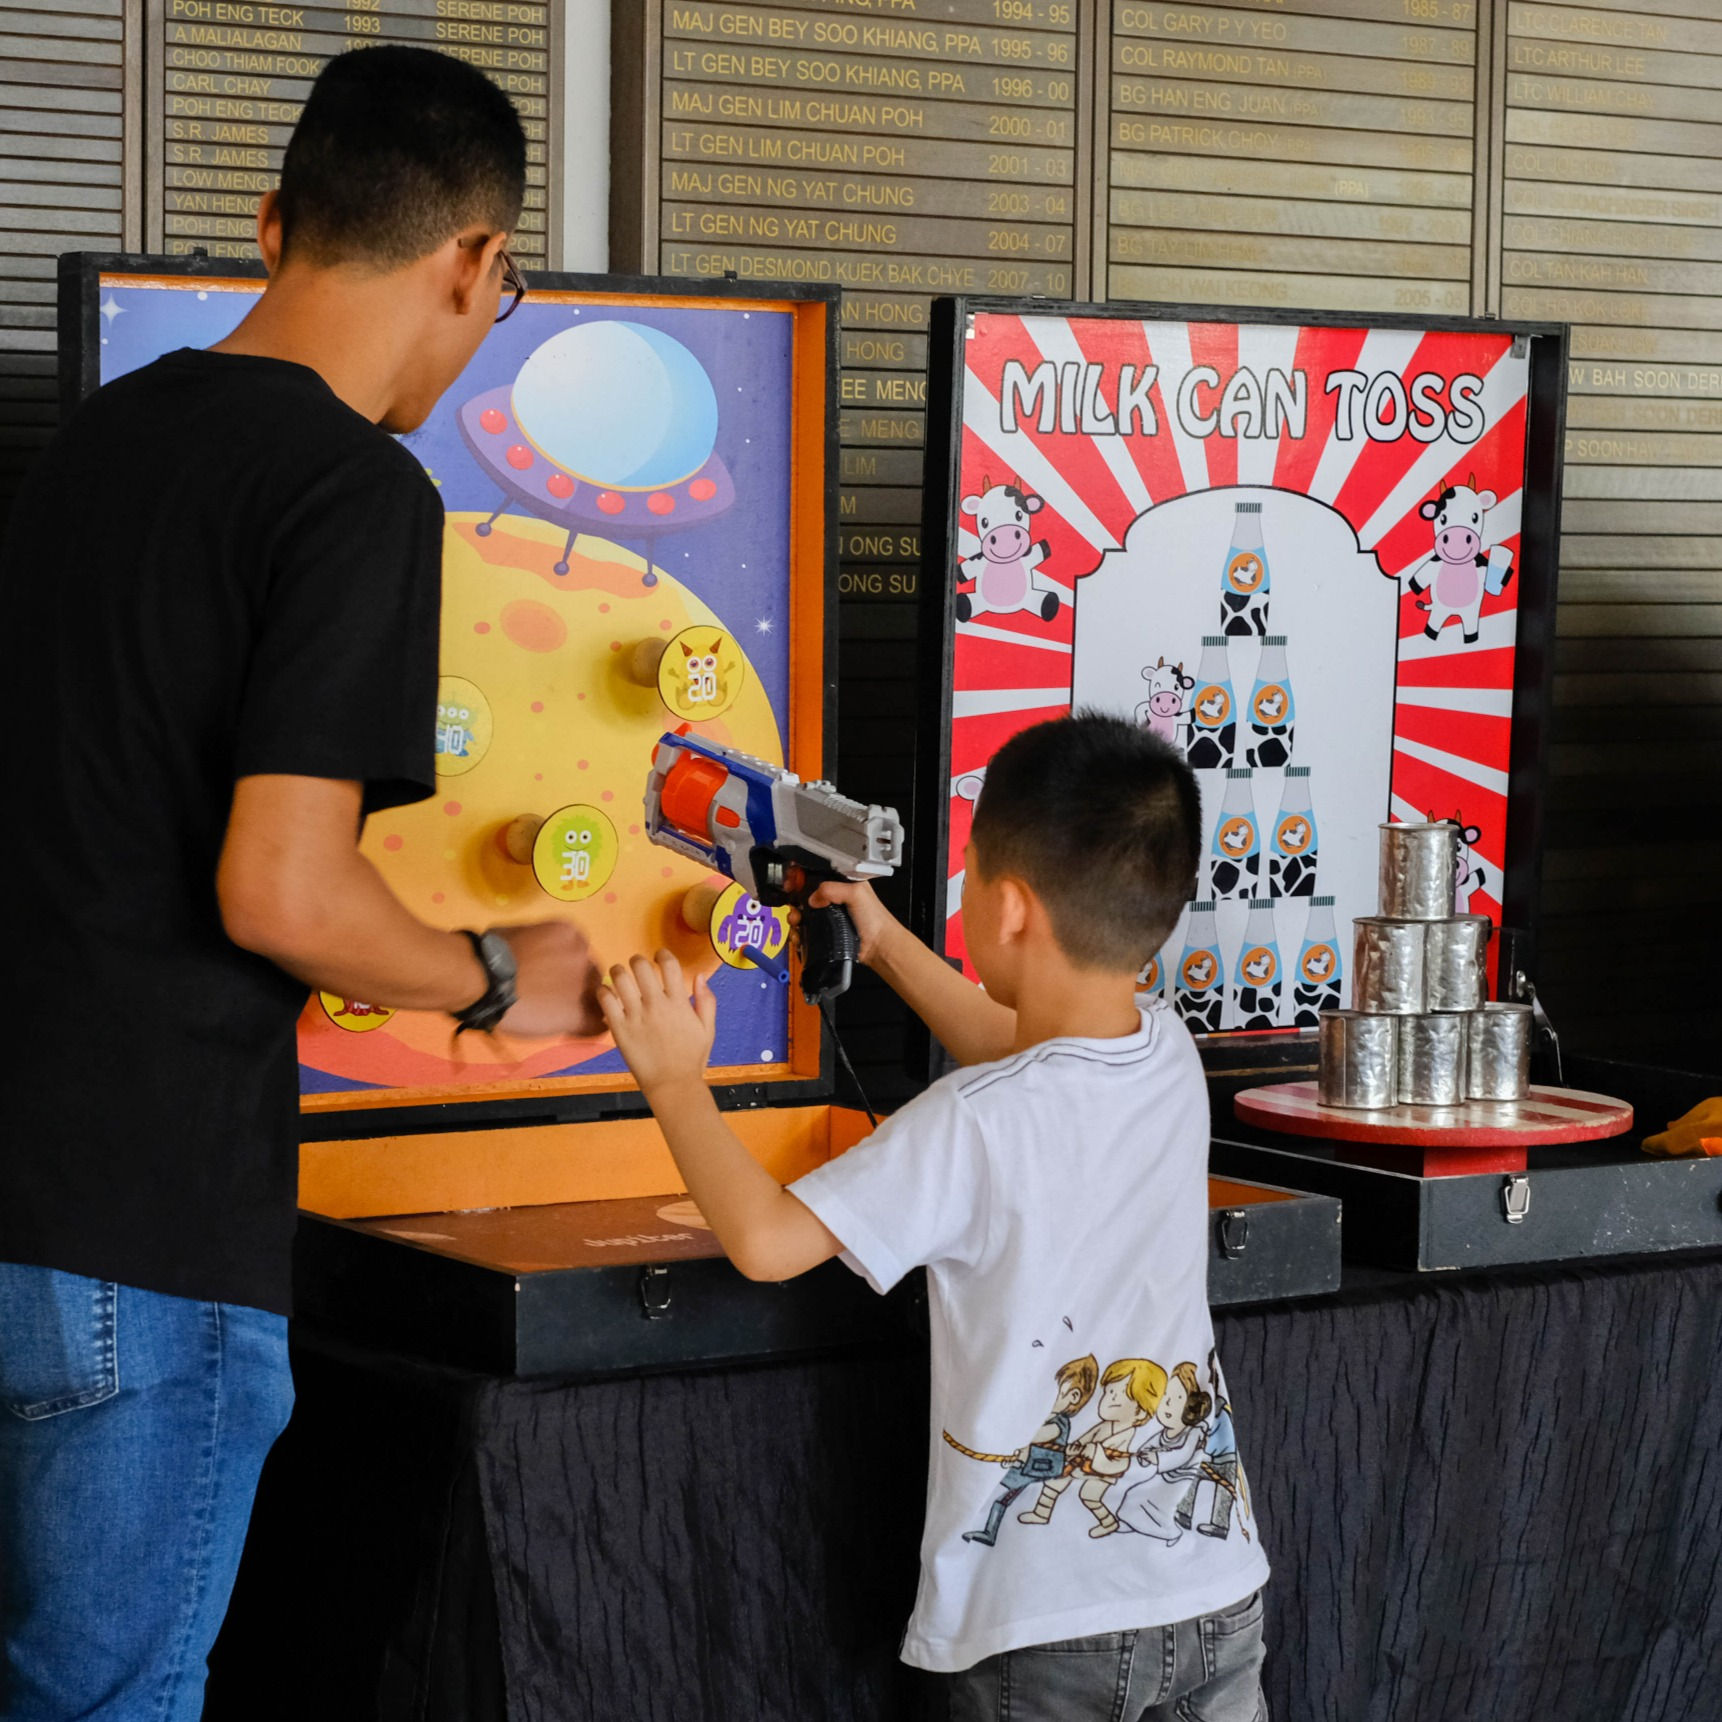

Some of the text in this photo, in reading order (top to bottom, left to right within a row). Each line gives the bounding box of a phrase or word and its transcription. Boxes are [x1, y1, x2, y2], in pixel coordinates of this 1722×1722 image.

[173, 1, 381, 33] POH ENG TECK 1993
[436, 0, 542, 23] SERENE POH
[993, 0, 1070, 24] 1994 95
[435, 23, 543, 45] SERENE POH
[673, 10, 714, 32] MAJ
[719, 14, 763, 36] GEN
[768, 18, 808, 40] BEY
[814, 23, 858, 44] SOO
[945, 33, 982, 55] PPA
[992, 38, 1031, 59] 1995
[1047, 43, 1068, 62] 96
[1122, 9, 1158, 30] COL
[1164, 12, 1213, 33] GARY
[1219, 17, 1229, 35] P
[1234, 20, 1246, 37] Y
[1250, 21, 1287, 41] YEO
[1514, 11, 1666, 42] LTC CLARENCE TAN
[173, 49, 320, 75] CHOO THIAM FOOK
[508, 51, 543, 69] POH
[1121, 46, 1158, 67] COL
[1163, 49, 1251, 74] RAYMOND
[1256, 57, 1288, 76] TAN
[1514, 46, 1645, 75] LTC ARTHUR LEE
[173, 73, 272, 96] CARL CHAY
[507, 75, 542, 92] POH
[673, 51, 696, 71] LT
[702, 53, 745, 75] GEN
[751, 57, 791, 78] BEY
[796, 61, 840, 82] SOO
[928, 71, 965, 93] PPA
[992, 77, 1032, 97] 1996
[1048, 81, 1069, 100] 00
[1120, 85, 1146, 104] BG
[1151, 87, 1188, 107] HAN
[1193, 90, 1231, 111] ENG
[1239, 95, 1285, 114] JUAN
[1513, 81, 1543, 102] LTC
[173, 98, 302, 122] POH ENG TECK
[514, 99, 542, 117] OH
[672, 91, 1065, 138] MAJ GEN LIM CHUAN POH 2000 01
[211, 125, 268, 144] JAMES
[1119, 123, 1145, 142] BG
[1150, 124, 1224, 147] PATRICK
[1228, 130, 1279, 149] CHOY
[211, 149, 268, 168] JAMES
[672, 132, 1066, 177] LT GEN LIM CHUAN POH 2001 03
[173, 170, 213, 186] LOW
[218, 173, 269, 191] MENG
[174, 195, 208, 210] YAN
[671, 172, 1065, 215] MAJ GEN NG YAT CHUNG 2003 04
[173, 217, 250, 237] POH ENG
[517, 212, 541, 228] OH
[672, 212, 1065, 253] LT GEN NG YAT CHUNG 2004 07
[671, 253, 691, 272] LT
[696, 254, 735, 274] GEN
[740, 256, 831, 279] DESMOND
[836, 262, 883, 283] KUEK
[888, 265, 922, 284] BAK
[927, 266, 975, 287] CHYE
[1510, 259, 1648, 284] COL TAN KAH HAN
[866, 302, 923, 323] HONG
[846, 341, 904, 361] HONG
[841, 379, 867, 399] EE
[1592, 368, 1626, 386] BAH
[1634, 370, 1680, 388] SOON
[1000, 359, 1485, 444] MILK CAN TOSS
[861, 419, 919, 439] MENG
[1577, 439, 1623, 457] SOON
[844, 456, 876, 475] LIM
[850, 536, 893, 556] ONG
[889, 575, 916, 593] SU
[688, 672, 717, 702] 20
[560, 851, 590, 881] 30
[734, 917, 762, 946] 20
